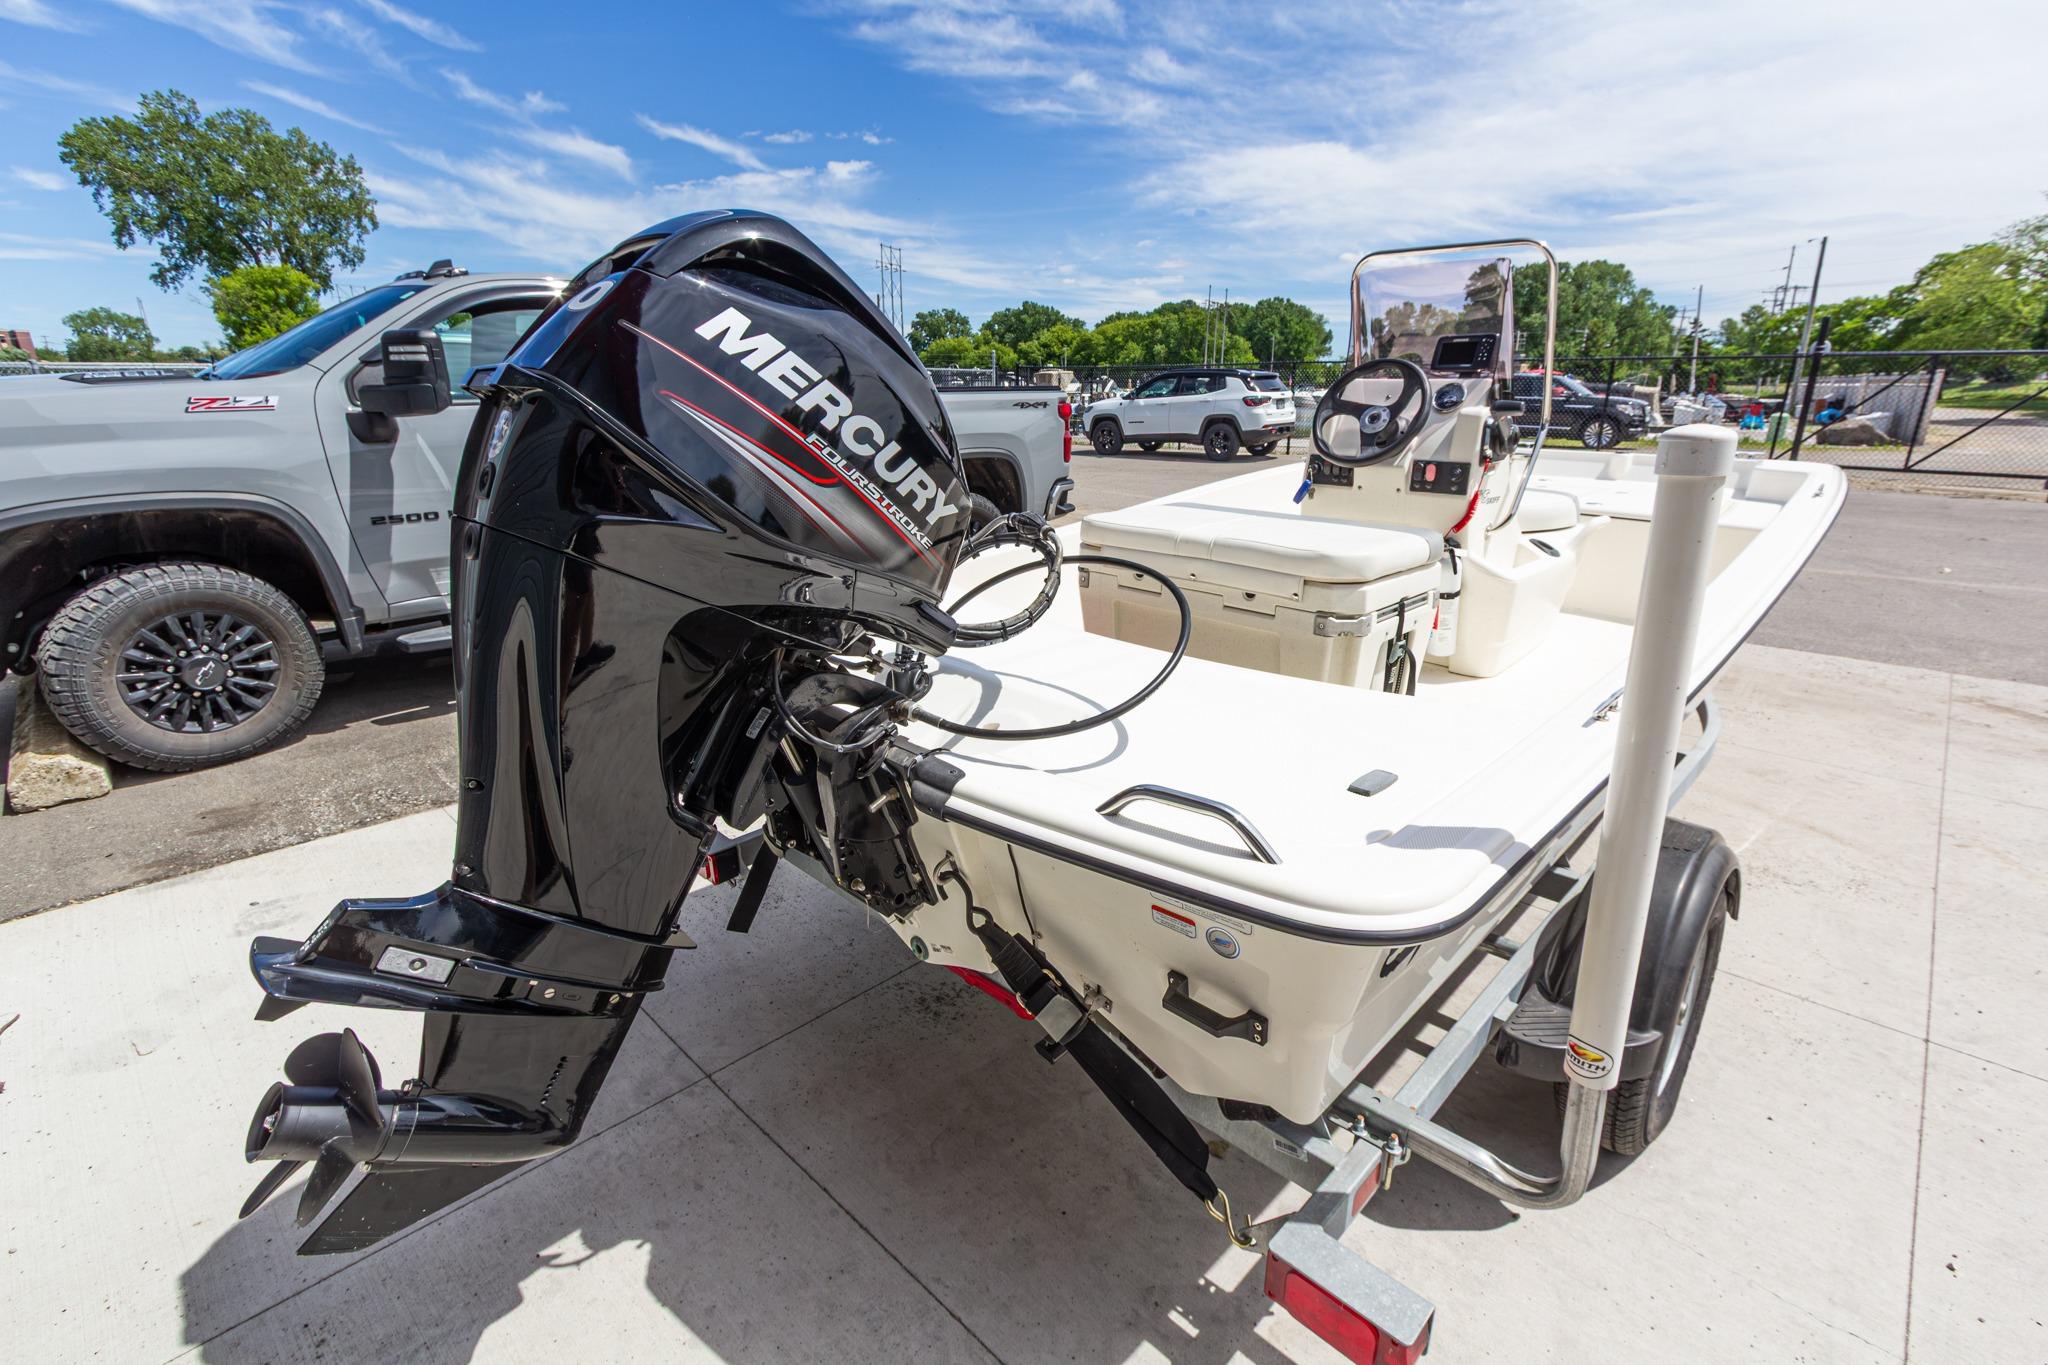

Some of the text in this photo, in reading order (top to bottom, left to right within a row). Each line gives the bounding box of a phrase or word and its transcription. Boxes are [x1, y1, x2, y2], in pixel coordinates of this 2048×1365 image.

[184, 396, 279, 413] Z71
[694, 306, 959, 526] MERCURY
[370, 511, 440, 526] 2500
[805, 432, 934, 549] FOURSTROKE
